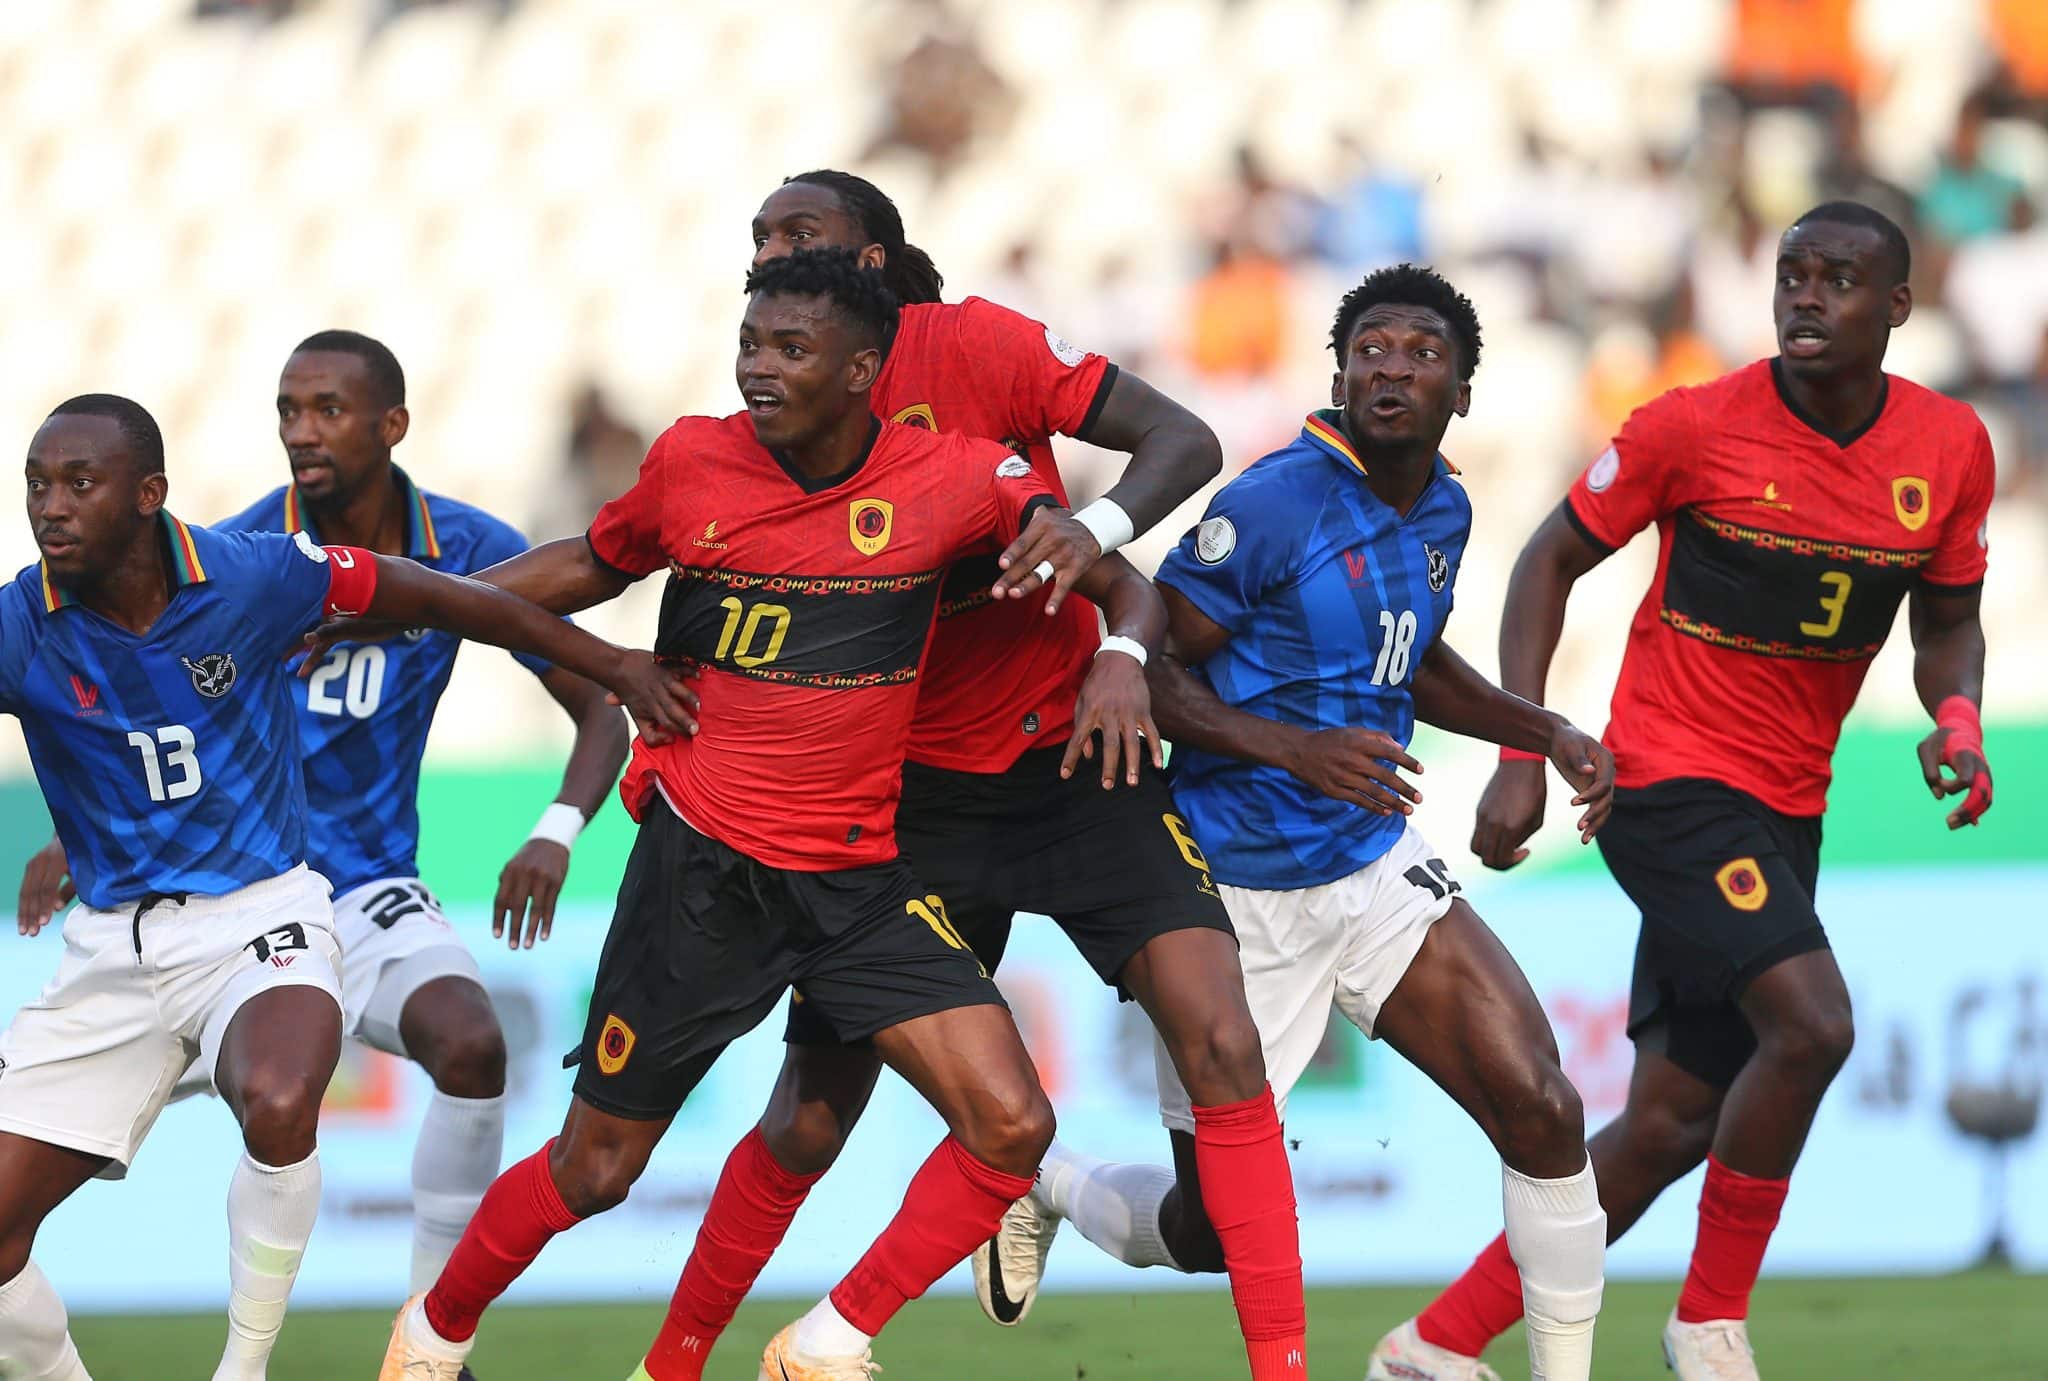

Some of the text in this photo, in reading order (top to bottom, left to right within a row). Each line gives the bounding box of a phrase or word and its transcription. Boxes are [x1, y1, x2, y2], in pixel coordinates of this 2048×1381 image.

[331, 549, 355, 569] C
[692, 536, 728, 550] Lacatoni
[714, 595, 791, 668] 10
[1799, 570, 1852, 638] 3
[306, 644, 386, 720] 20
[1368, 609, 1417, 687] 18
[127, 724, 202, 801] 13
[1162, 813, 1210, 873] 6
